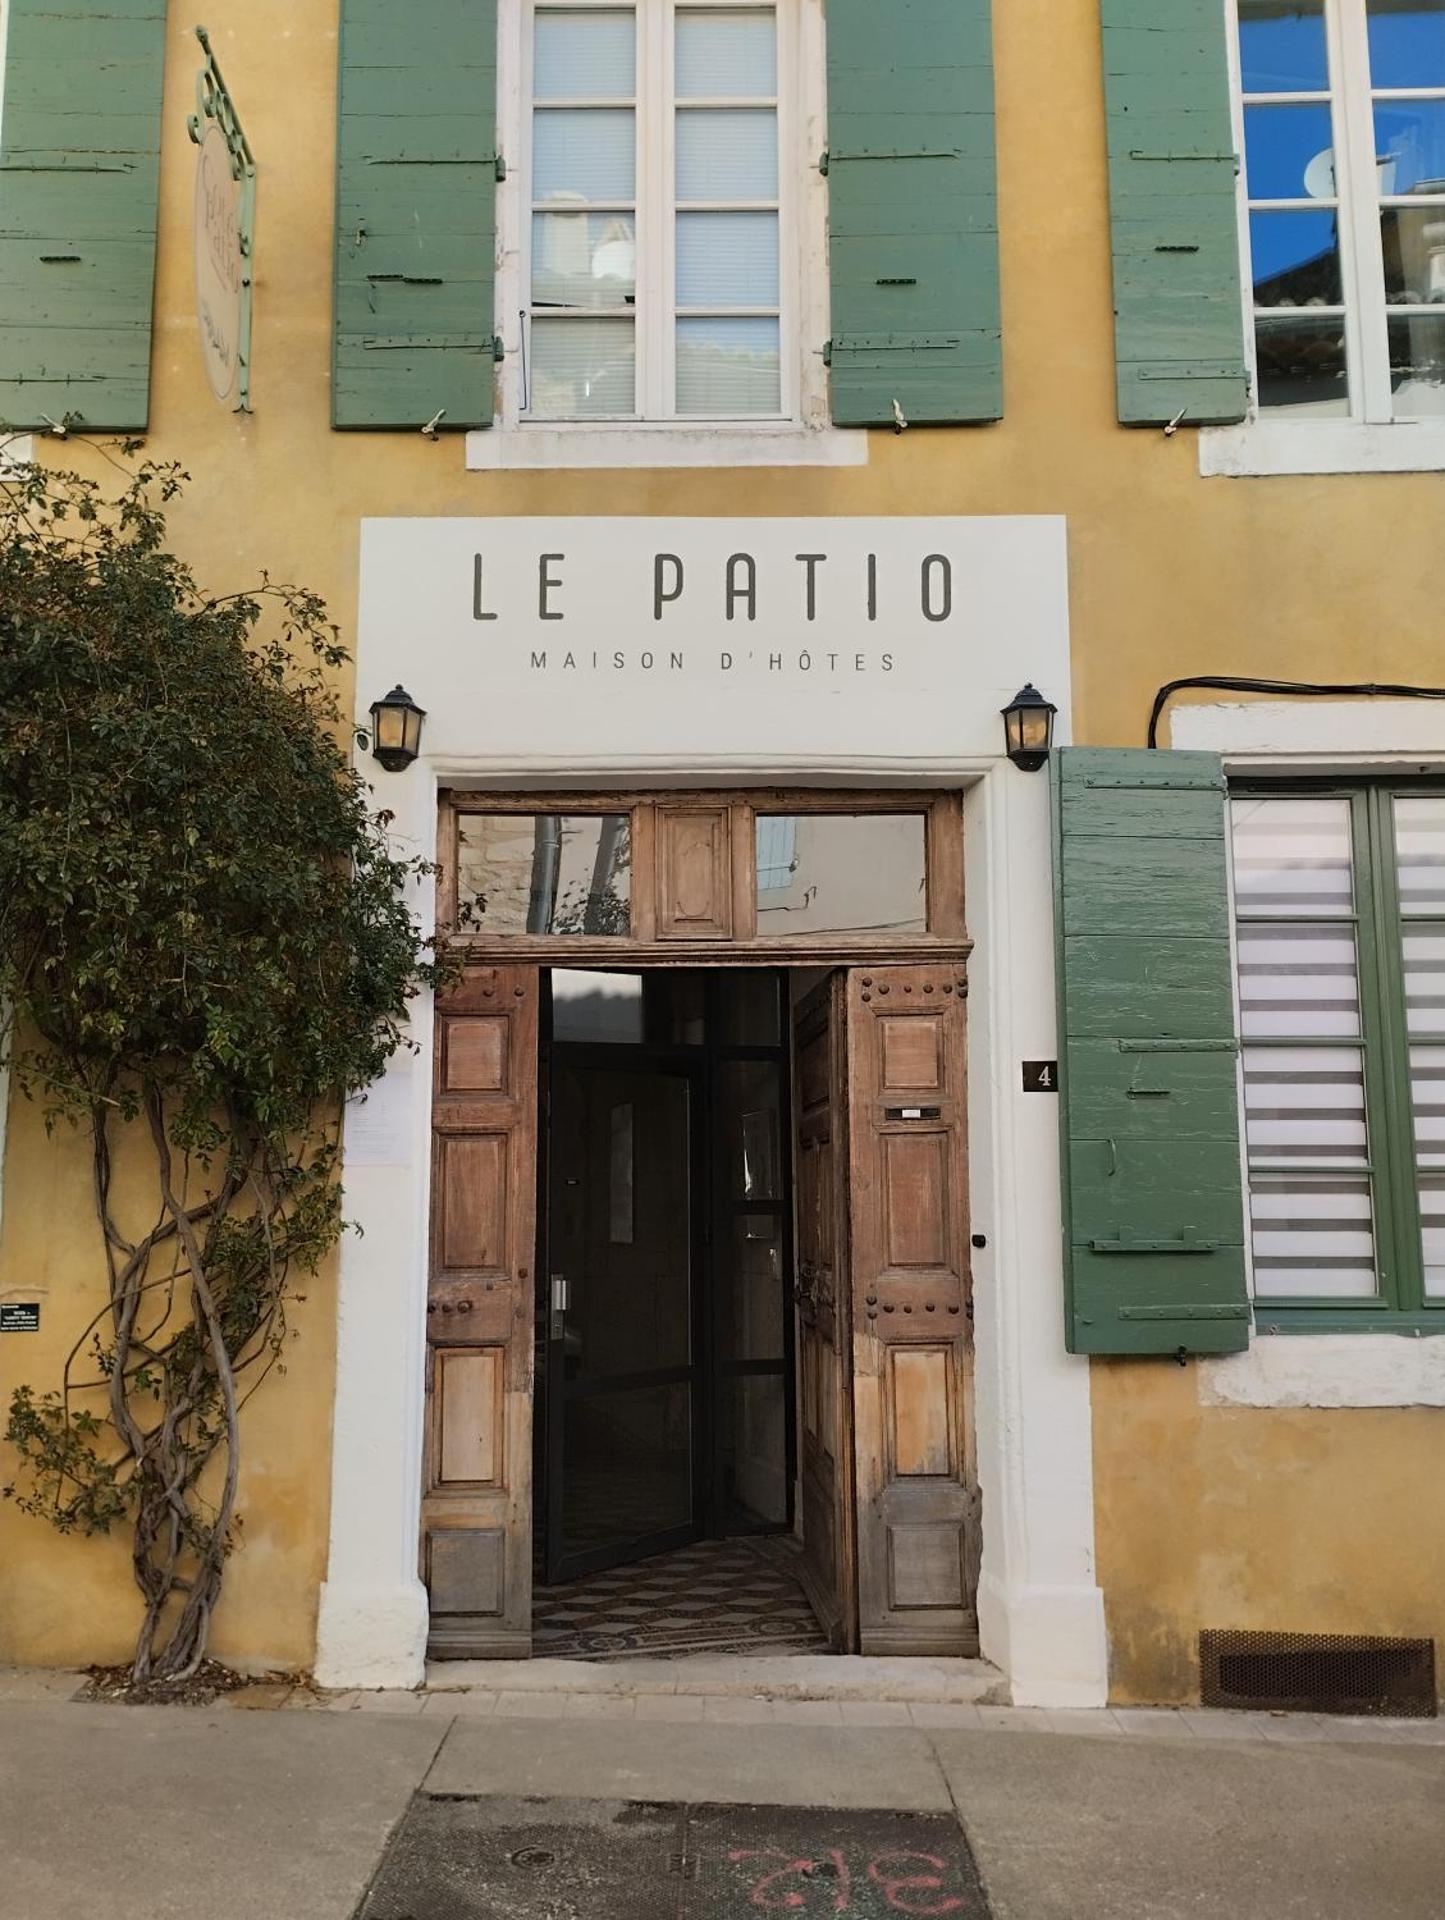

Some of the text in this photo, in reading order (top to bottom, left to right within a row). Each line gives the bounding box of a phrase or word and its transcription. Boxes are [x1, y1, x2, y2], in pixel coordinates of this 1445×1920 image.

[473, 552, 952, 622] LE PATIO
[531, 649, 893, 671] MAISON D'HÔTES
[1038, 1066, 1052, 1086] 4
